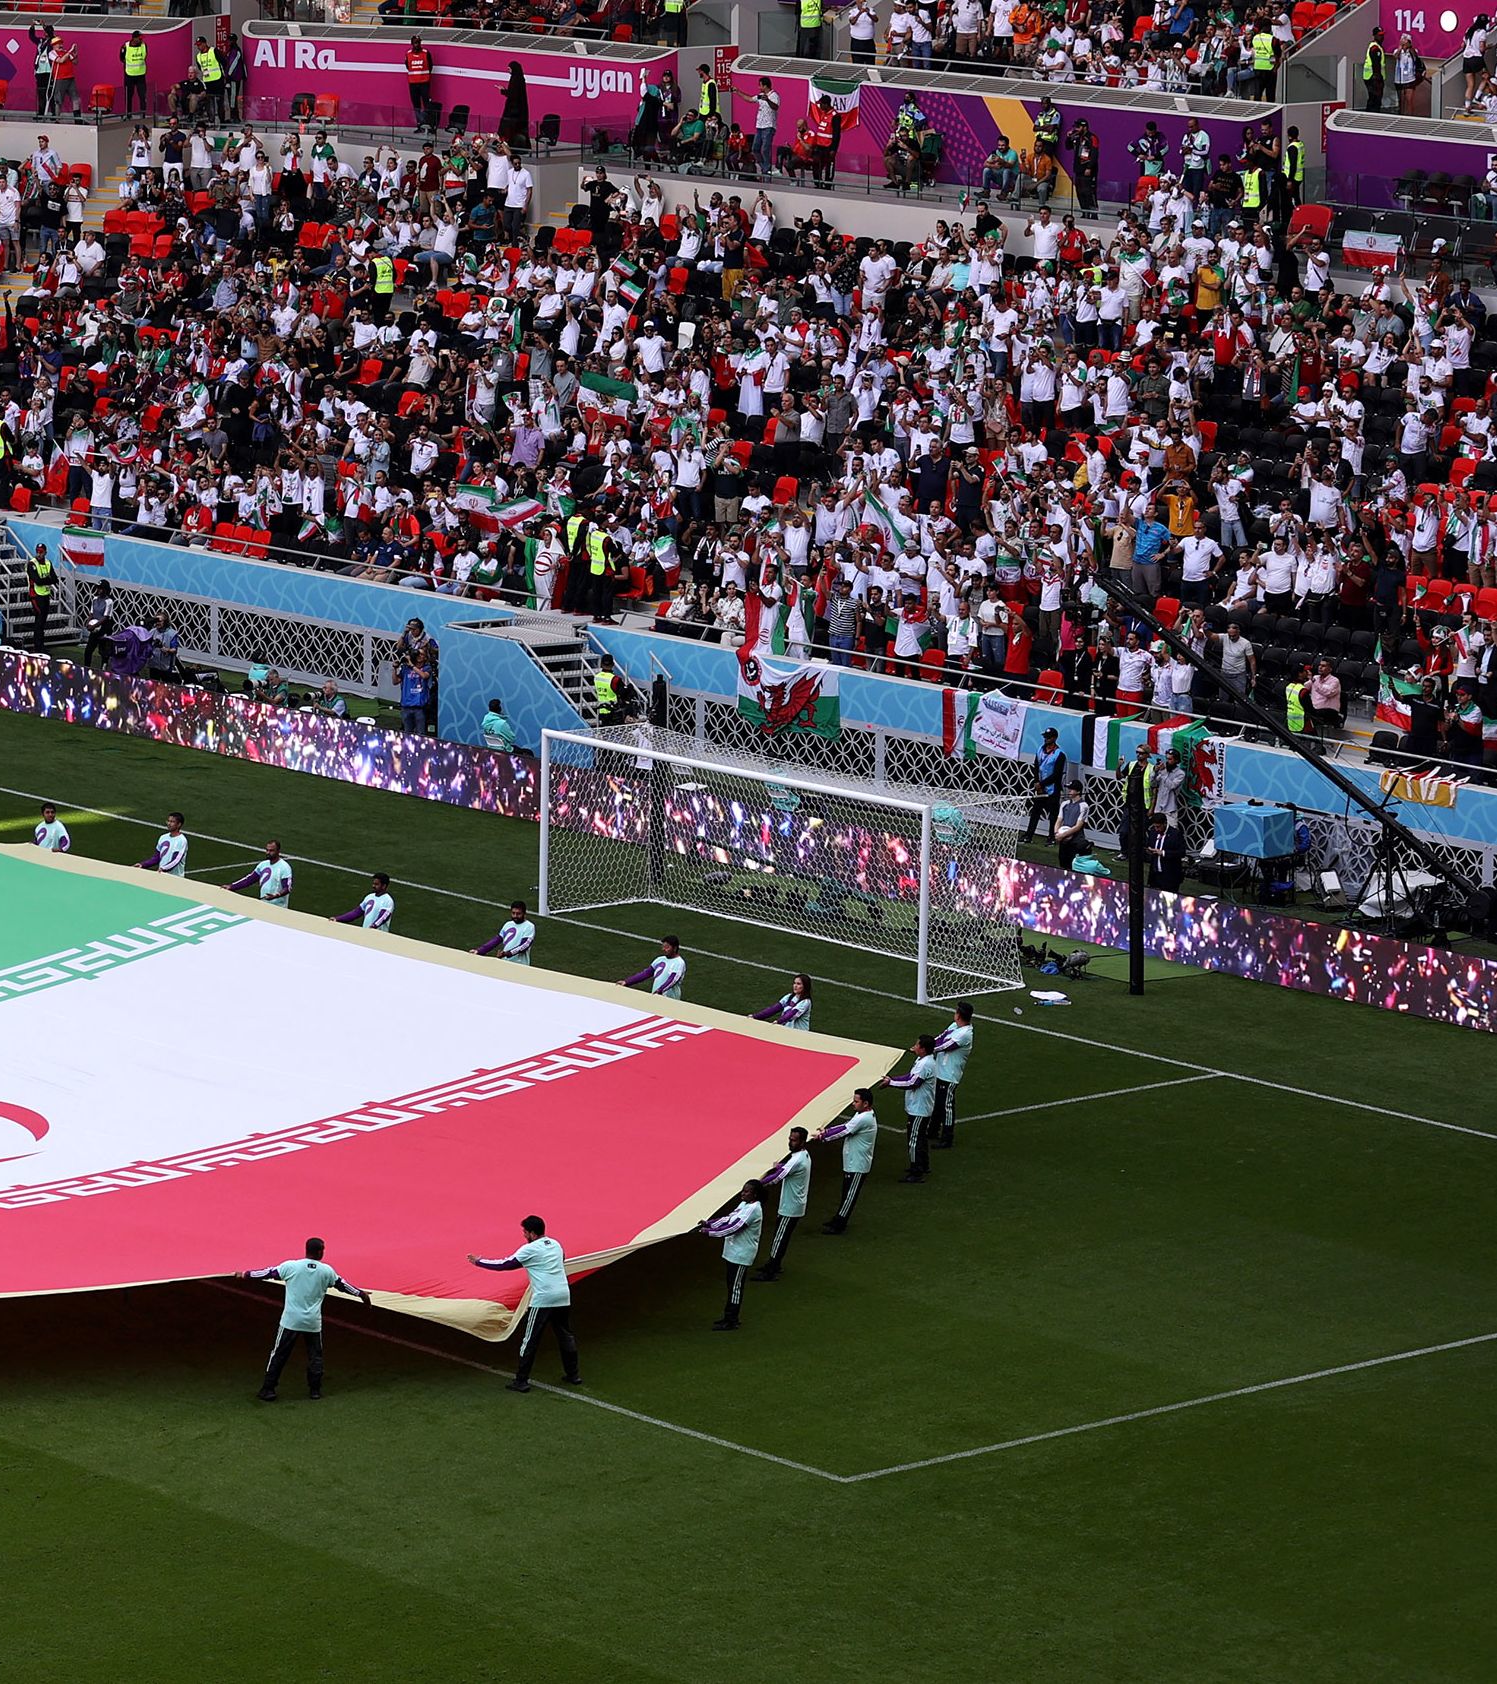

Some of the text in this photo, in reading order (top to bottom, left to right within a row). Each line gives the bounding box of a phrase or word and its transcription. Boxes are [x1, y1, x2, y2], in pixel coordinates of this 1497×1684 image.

[1394, 9, 1426, 33] 114
[216, 31, 228, 42] 116
[253, 38, 286, 69] Al
[717, 62, 732, 74] 115
[1216, 742, 1225, 798] CHEPSTOW
